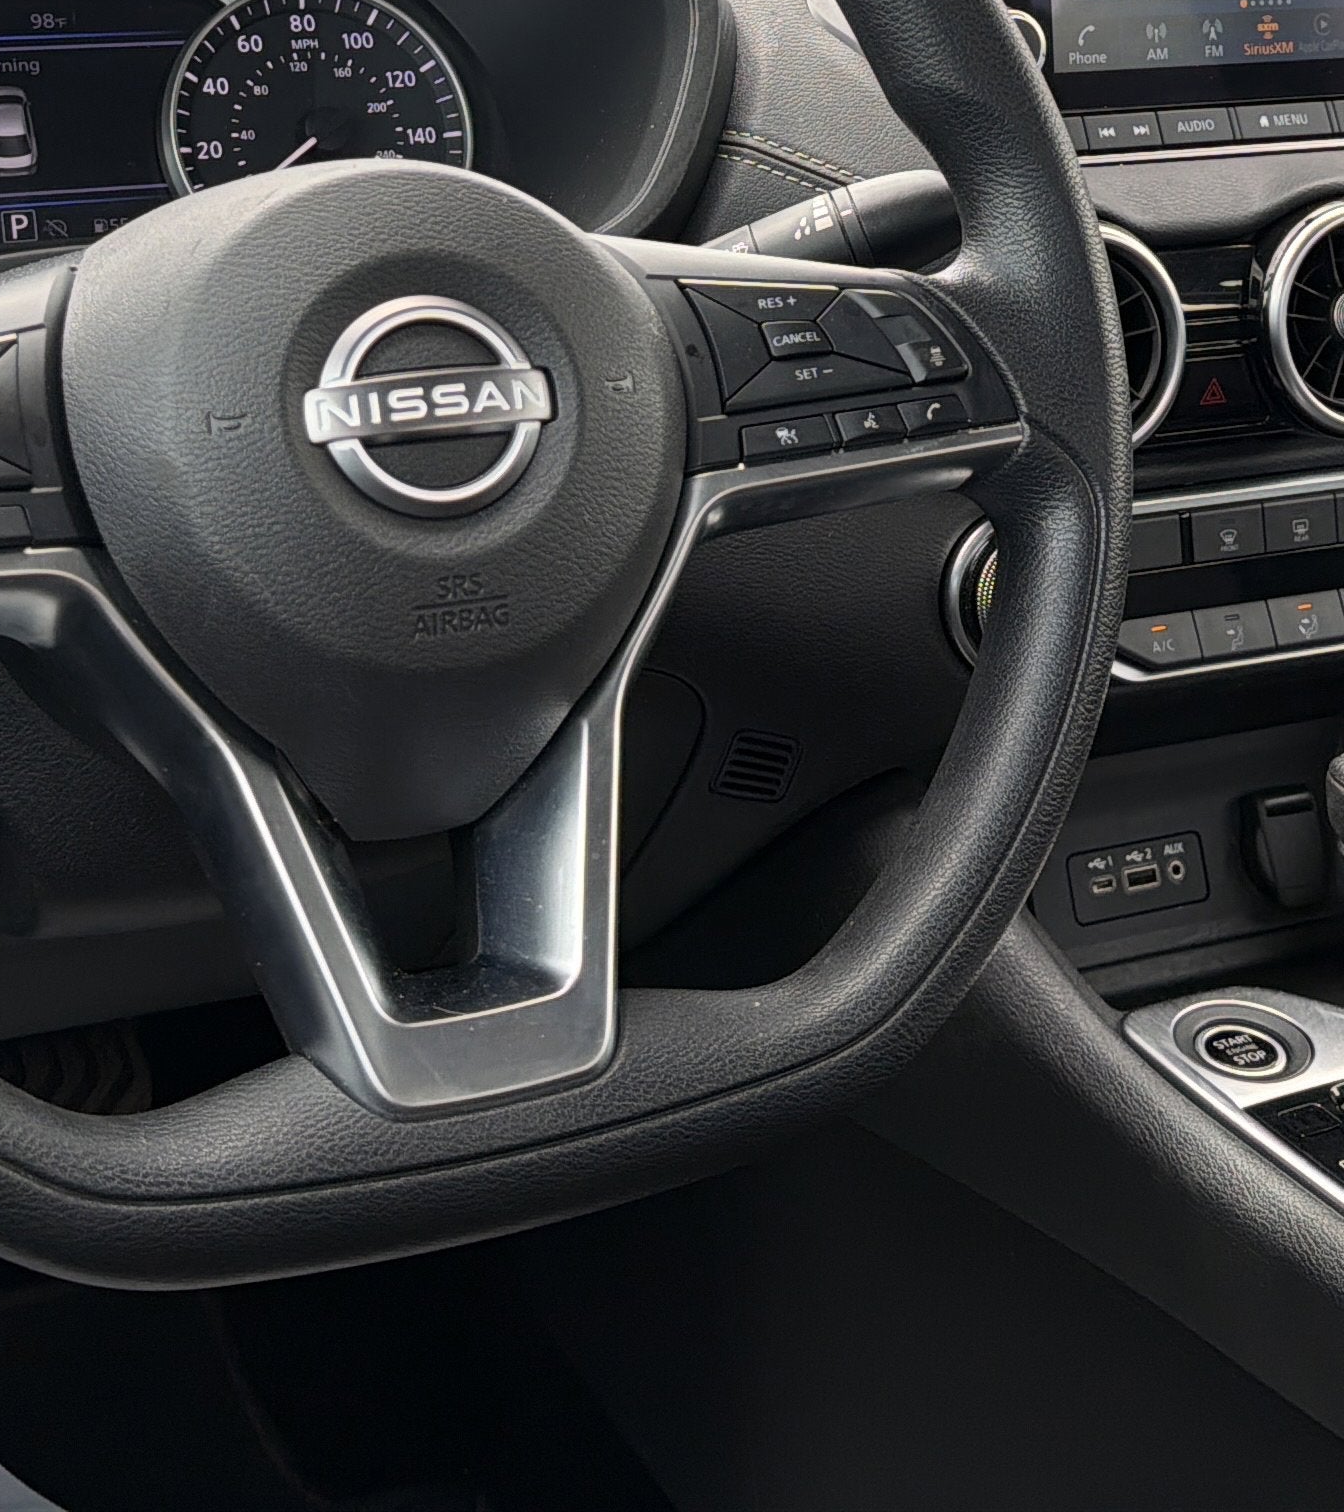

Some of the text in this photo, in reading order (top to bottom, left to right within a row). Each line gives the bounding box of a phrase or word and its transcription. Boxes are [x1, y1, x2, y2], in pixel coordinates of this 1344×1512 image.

[289, 14, 316, 32] 80
[237, 34, 263, 53] 60
[291, 38, 319, 51] MPH
[341, 32, 374, 49] 100
[1146, 47, 1169, 61] AM
[1205, 45, 1224, 58] FM
[1243, 41, 1294, 57] SiriusXM
[1068, 51, 1108, 65] Phone
[289, 61, 308, 73] 120
[333, 66, 352, 78] 160
[202, 77, 229, 95] 40
[385, 70, 416, 88] 120
[253, 84, 269, 96] 80
[366, 102, 387, 114] 200
[1176, 119, 1216, 133] AUDIO
[1272, 112, 1309, 127] MENU
[240, 129, 256, 141] 40
[406, 126, 437, 145] 140
[196, 141, 223, 160] 20
[9, 213, 29, 240] P
[757, 296, 784, 310] RES
[772, 330, 821, 347] CANCEL
[794, 366, 819, 381] SET
[317, 378, 547, 432] NISSAN
[437, 571, 484, 602] SRS
[413, 602, 511, 640] AIRBAG
[1152, 638, 1176, 654] A/C
[1212, 1034, 1254, 1050] START
[1232, 1049, 1267, 1066] STOP
